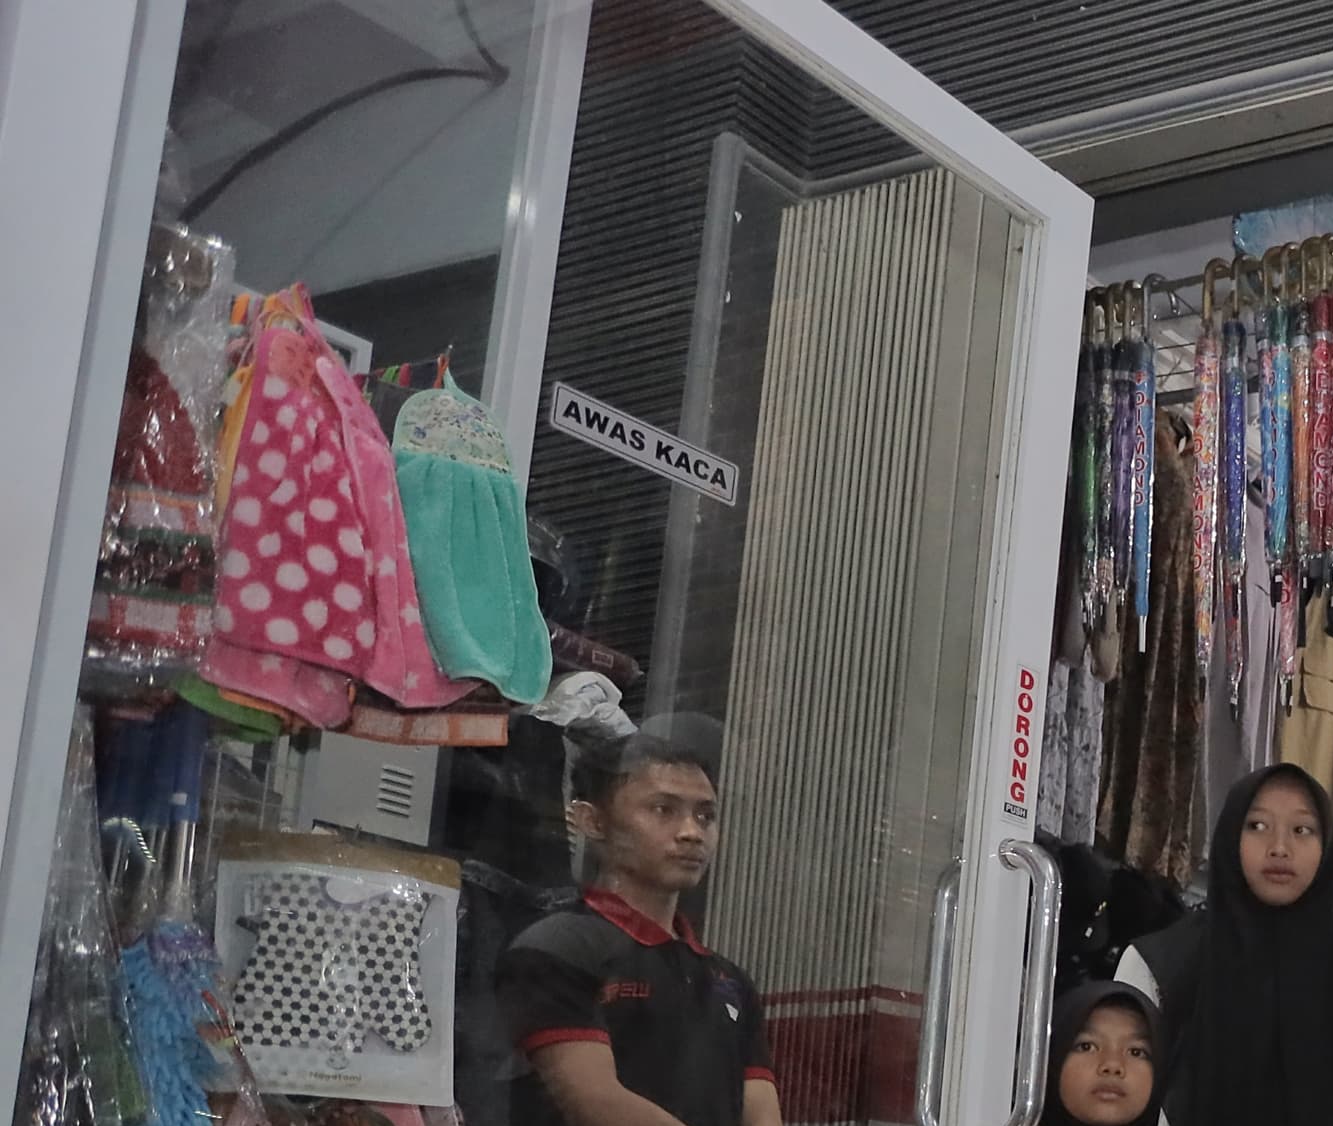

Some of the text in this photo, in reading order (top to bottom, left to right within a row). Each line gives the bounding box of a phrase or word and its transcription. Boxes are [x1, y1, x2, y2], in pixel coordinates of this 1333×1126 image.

[563, 400, 727, 489] AWAS KACA
[1134, 391, 1147, 505] DIAMOND
[1010, 669, 1035, 803] DORONG
[1006, 804, 1026, 817] PUSH
